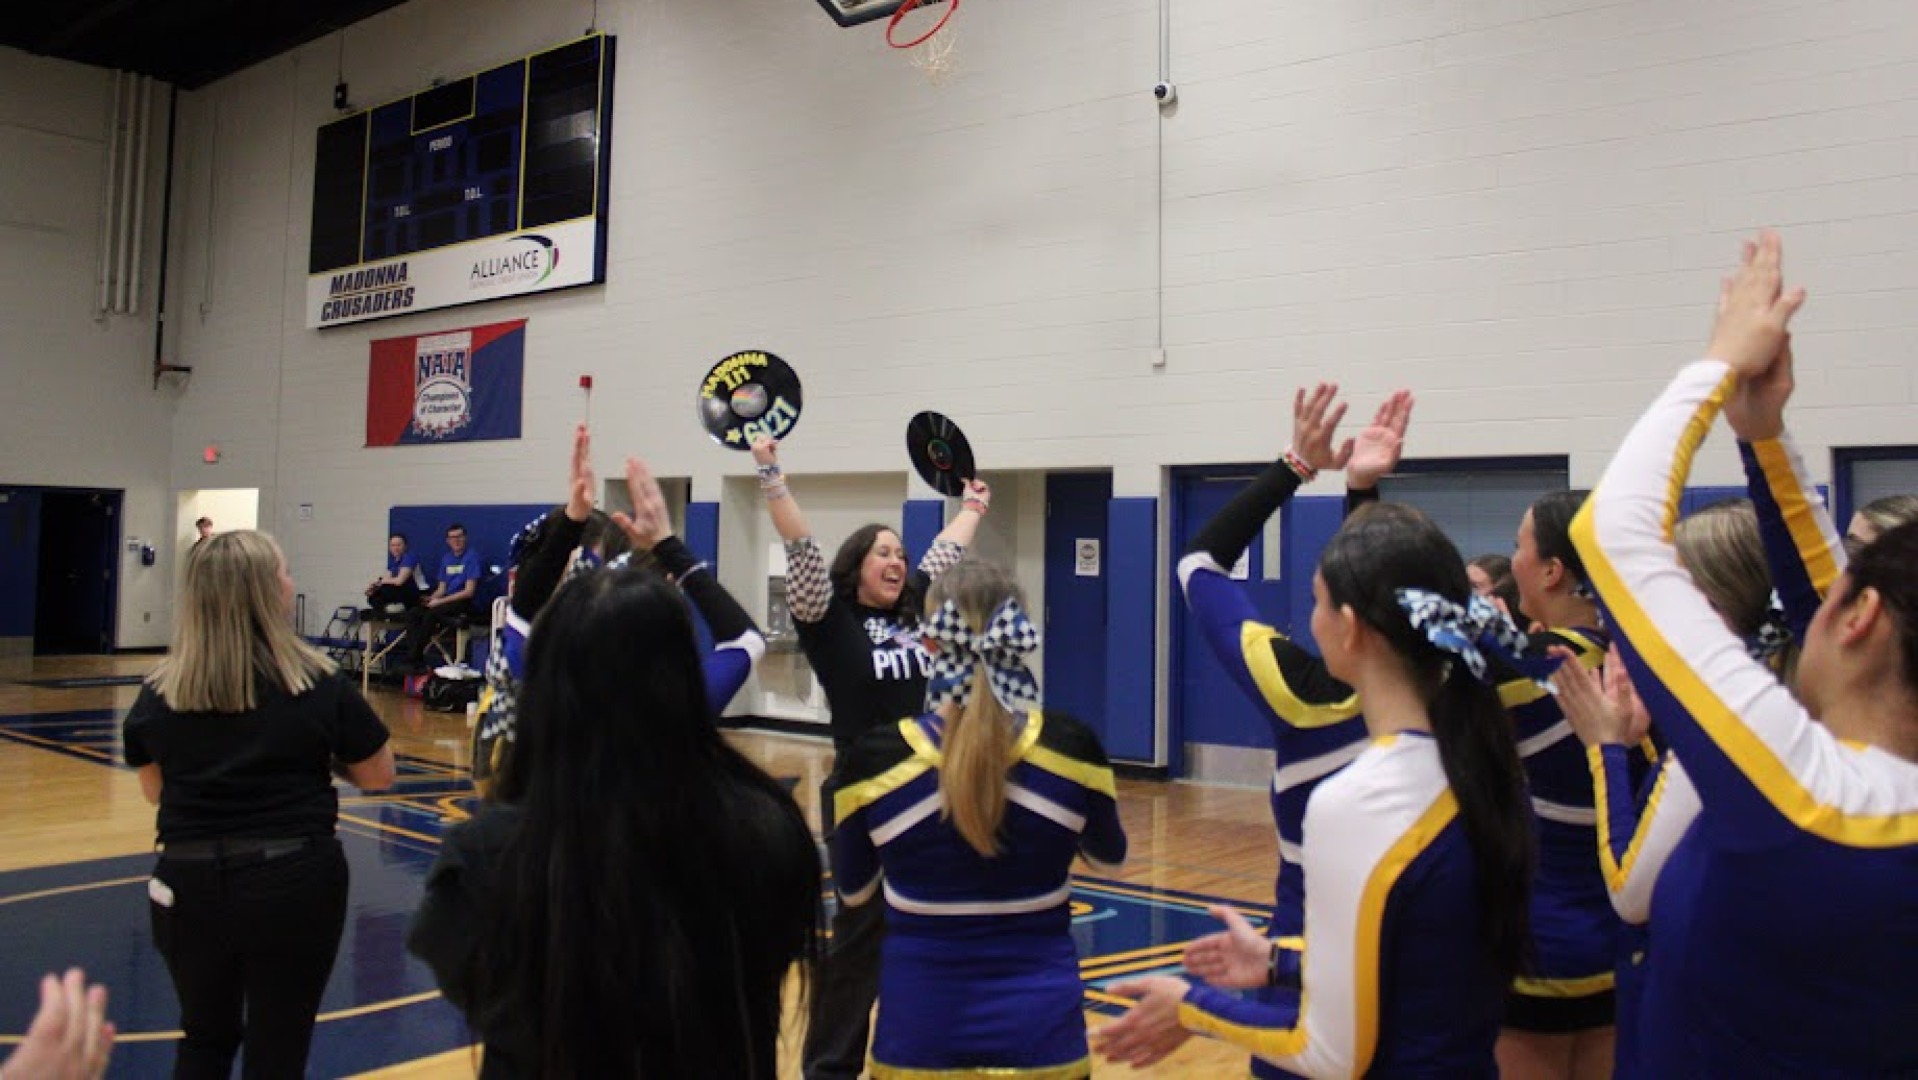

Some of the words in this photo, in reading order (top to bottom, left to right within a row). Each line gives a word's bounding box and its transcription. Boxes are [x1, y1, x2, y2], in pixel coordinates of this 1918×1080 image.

[330, 261, 407, 294] MADONNA
[470, 249, 539, 279] ALLIANCE
[320, 286, 415, 321] CRUSADERS
[416, 349, 467, 386] NAIA
[701, 352, 768, 399] MADONNA
[873, 649, 910, 680] PIT
